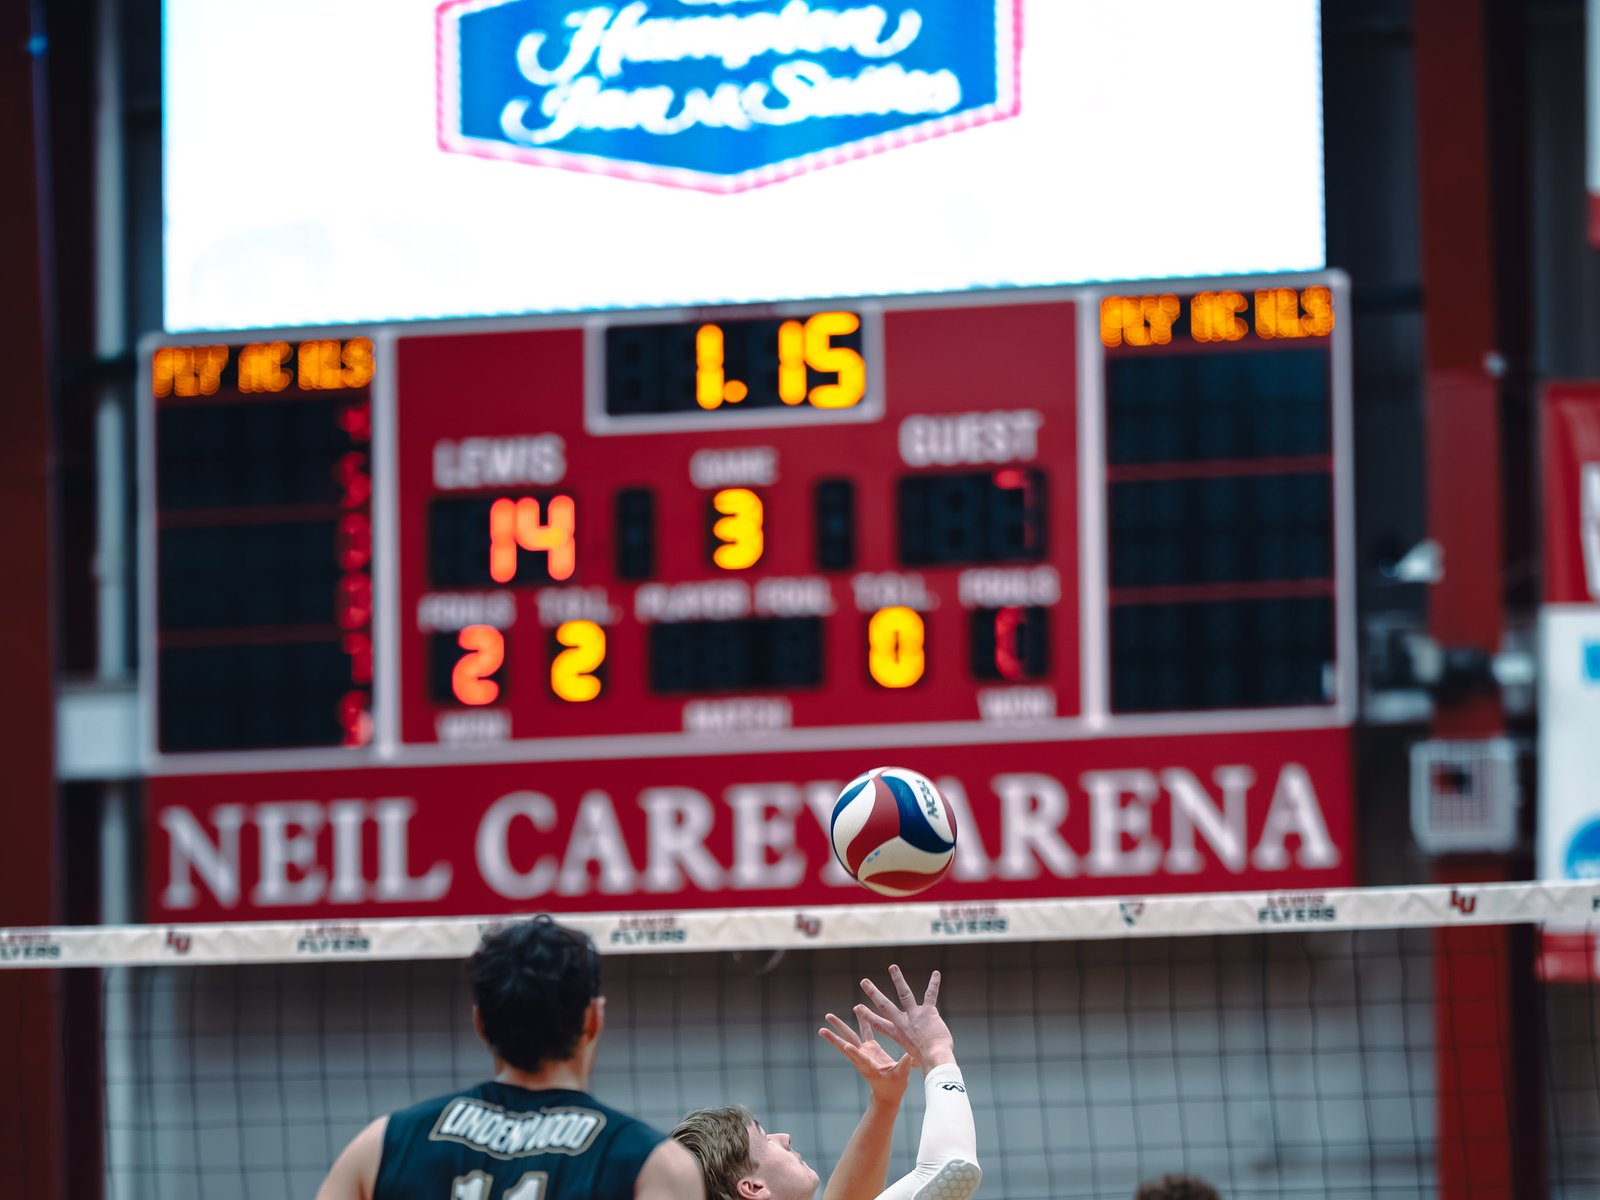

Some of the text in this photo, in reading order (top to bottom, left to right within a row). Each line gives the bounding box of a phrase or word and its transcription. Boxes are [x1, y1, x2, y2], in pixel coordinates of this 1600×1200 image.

[433, 434, 567, 489] LEWIS
[898, 410, 1044, 466] GUEST
[489, 494, 576, 583] 14
[713, 488, 764, 570] 3
[452, 624, 505, 706] 2
[551, 619, 606, 702] 2
[868, 605, 925, 689] 0
[158, 796, 453, 911] NEIL
[935, 762, 1340, 883] ARENA
[610, 929, 685, 945] FLYERS
[930, 919, 1007, 935] FLYERS
[1257, 905, 1336, 924] FLYERS
[0, 943, 62, 961] LYERS
[297, 938, 371, 953] FLYERS
[437, 1102, 600, 1155] LINDENWOOD
